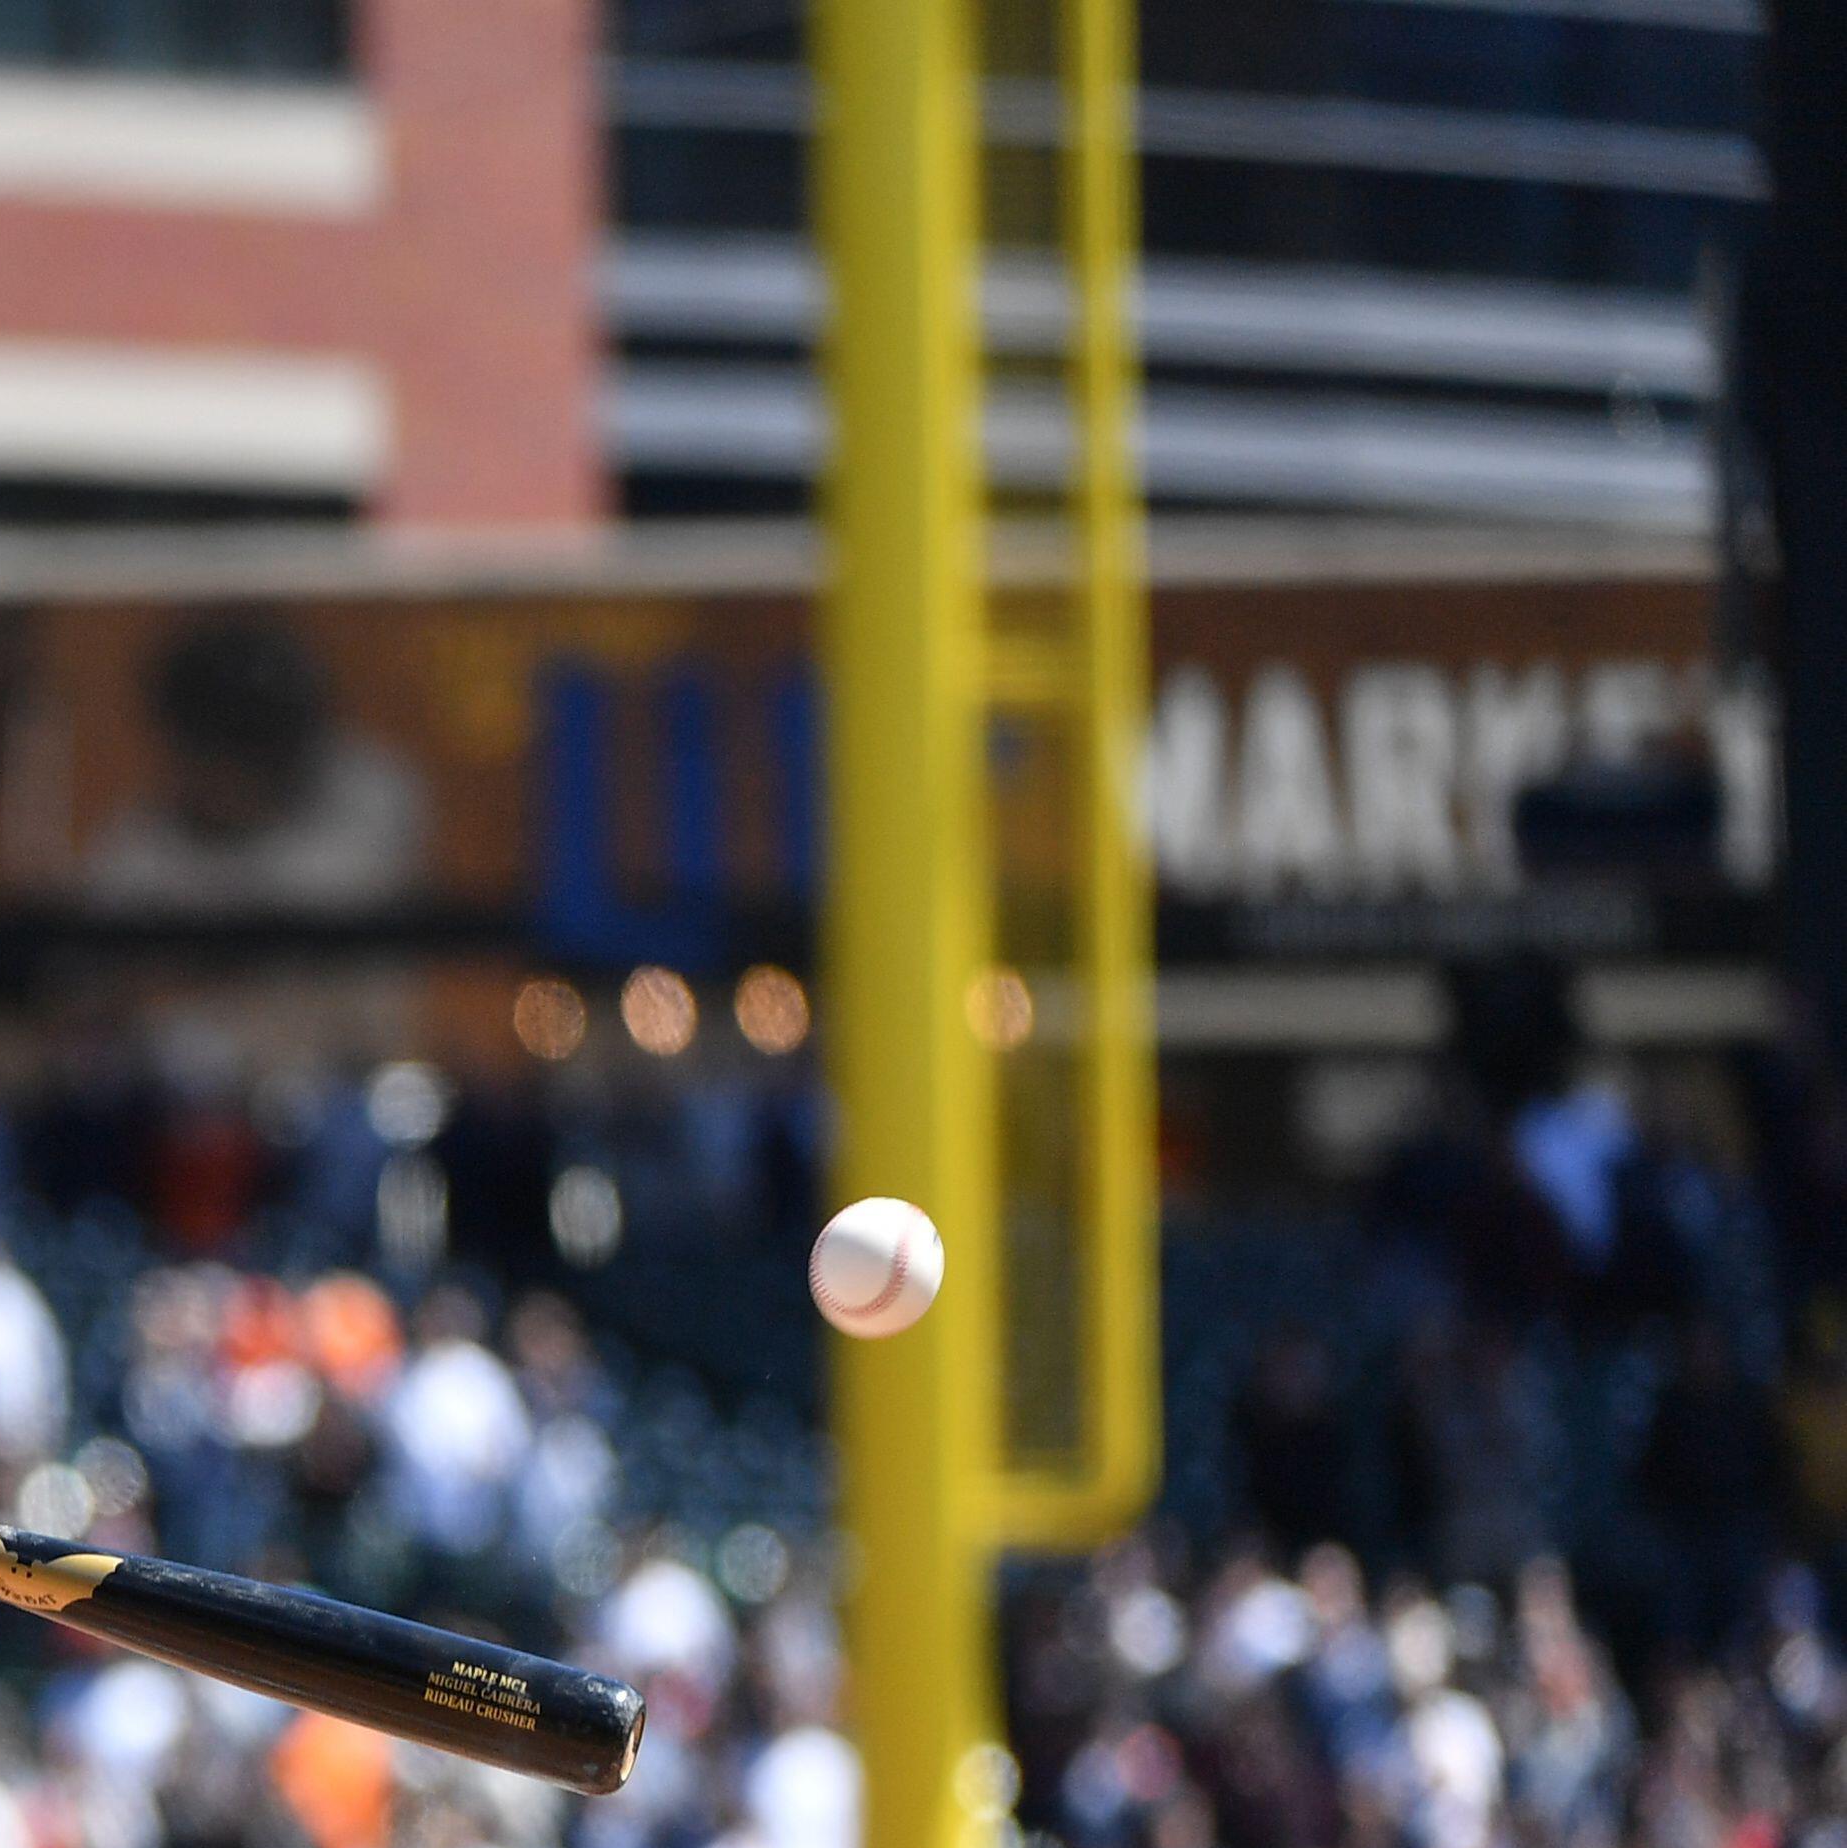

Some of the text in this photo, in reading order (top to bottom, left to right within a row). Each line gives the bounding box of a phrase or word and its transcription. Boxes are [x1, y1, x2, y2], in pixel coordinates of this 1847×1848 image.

[428, 1671, 541, 1715] MIGUEL CABRERA
[452, 1661, 498, 1685] MAPLE
[424, 1687, 536, 1732] RIDEAU CRUSHER
